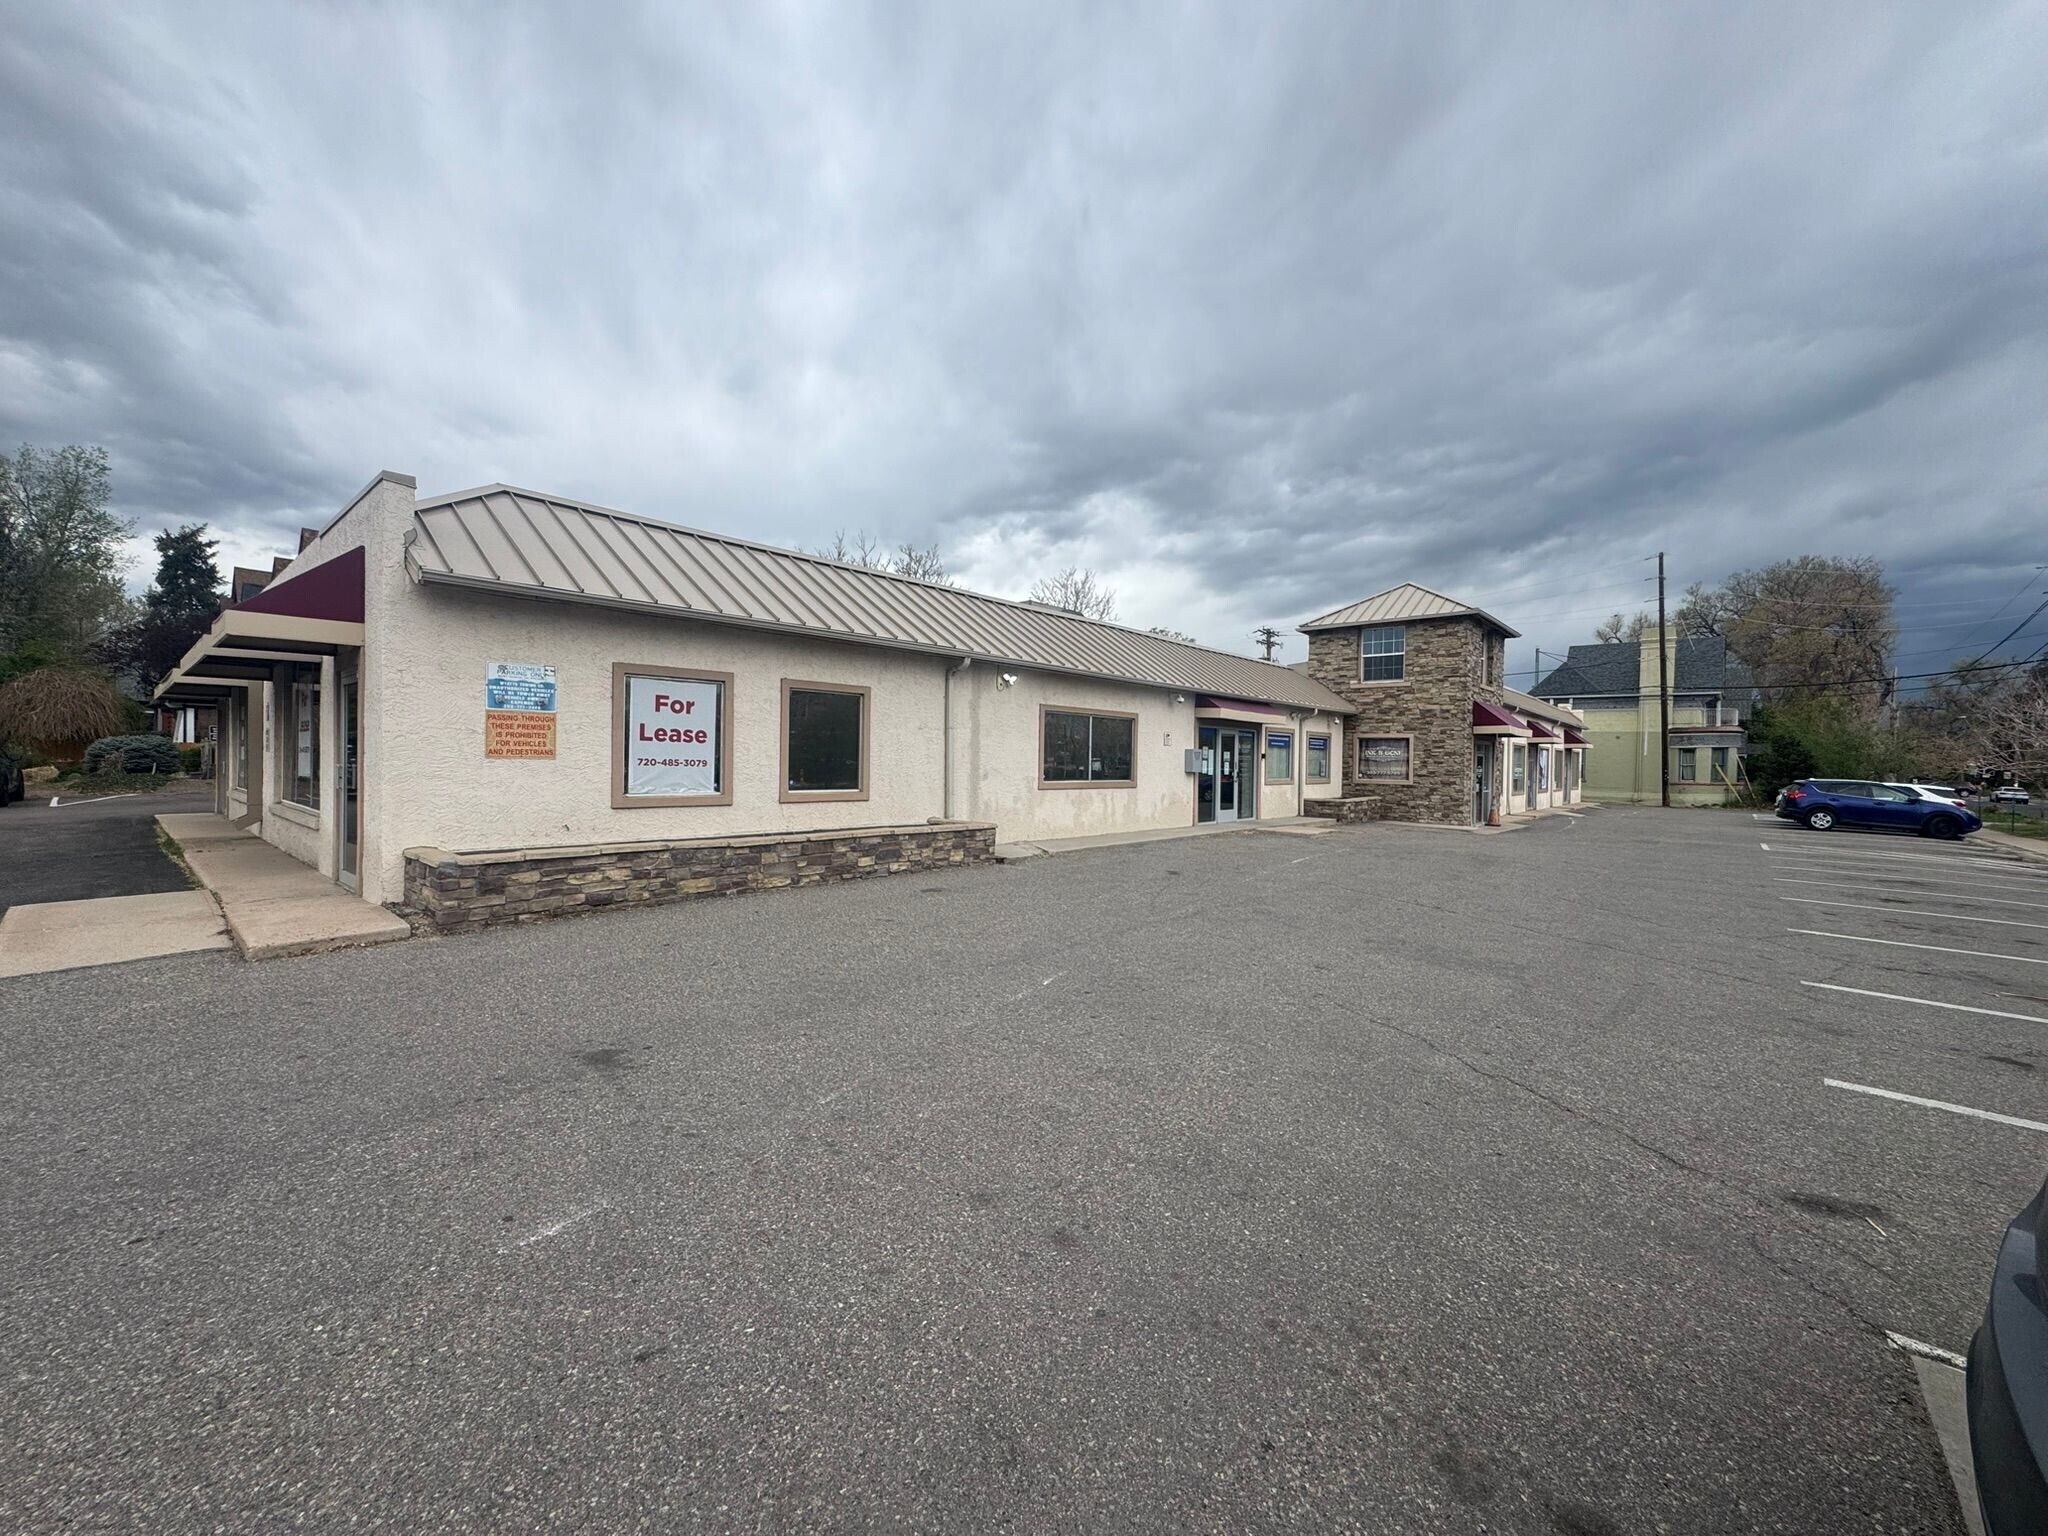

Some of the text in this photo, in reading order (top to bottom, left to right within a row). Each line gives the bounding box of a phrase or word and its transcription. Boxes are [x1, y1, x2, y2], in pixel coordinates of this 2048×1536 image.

[655, 694, 695, 714] For
[487, 713, 555, 723] PASSING THROUGH
[491, 722, 552, 731] THESE PREMISES
[505, 731, 547, 739] PROHIBITED
[639, 723, 708, 744] Lease
[513, 740, 547, 748] VEHICLES
[506, 748, 554, 756] PEDESTRIANS
[637, 758, 708, 767] 720-485-3079
